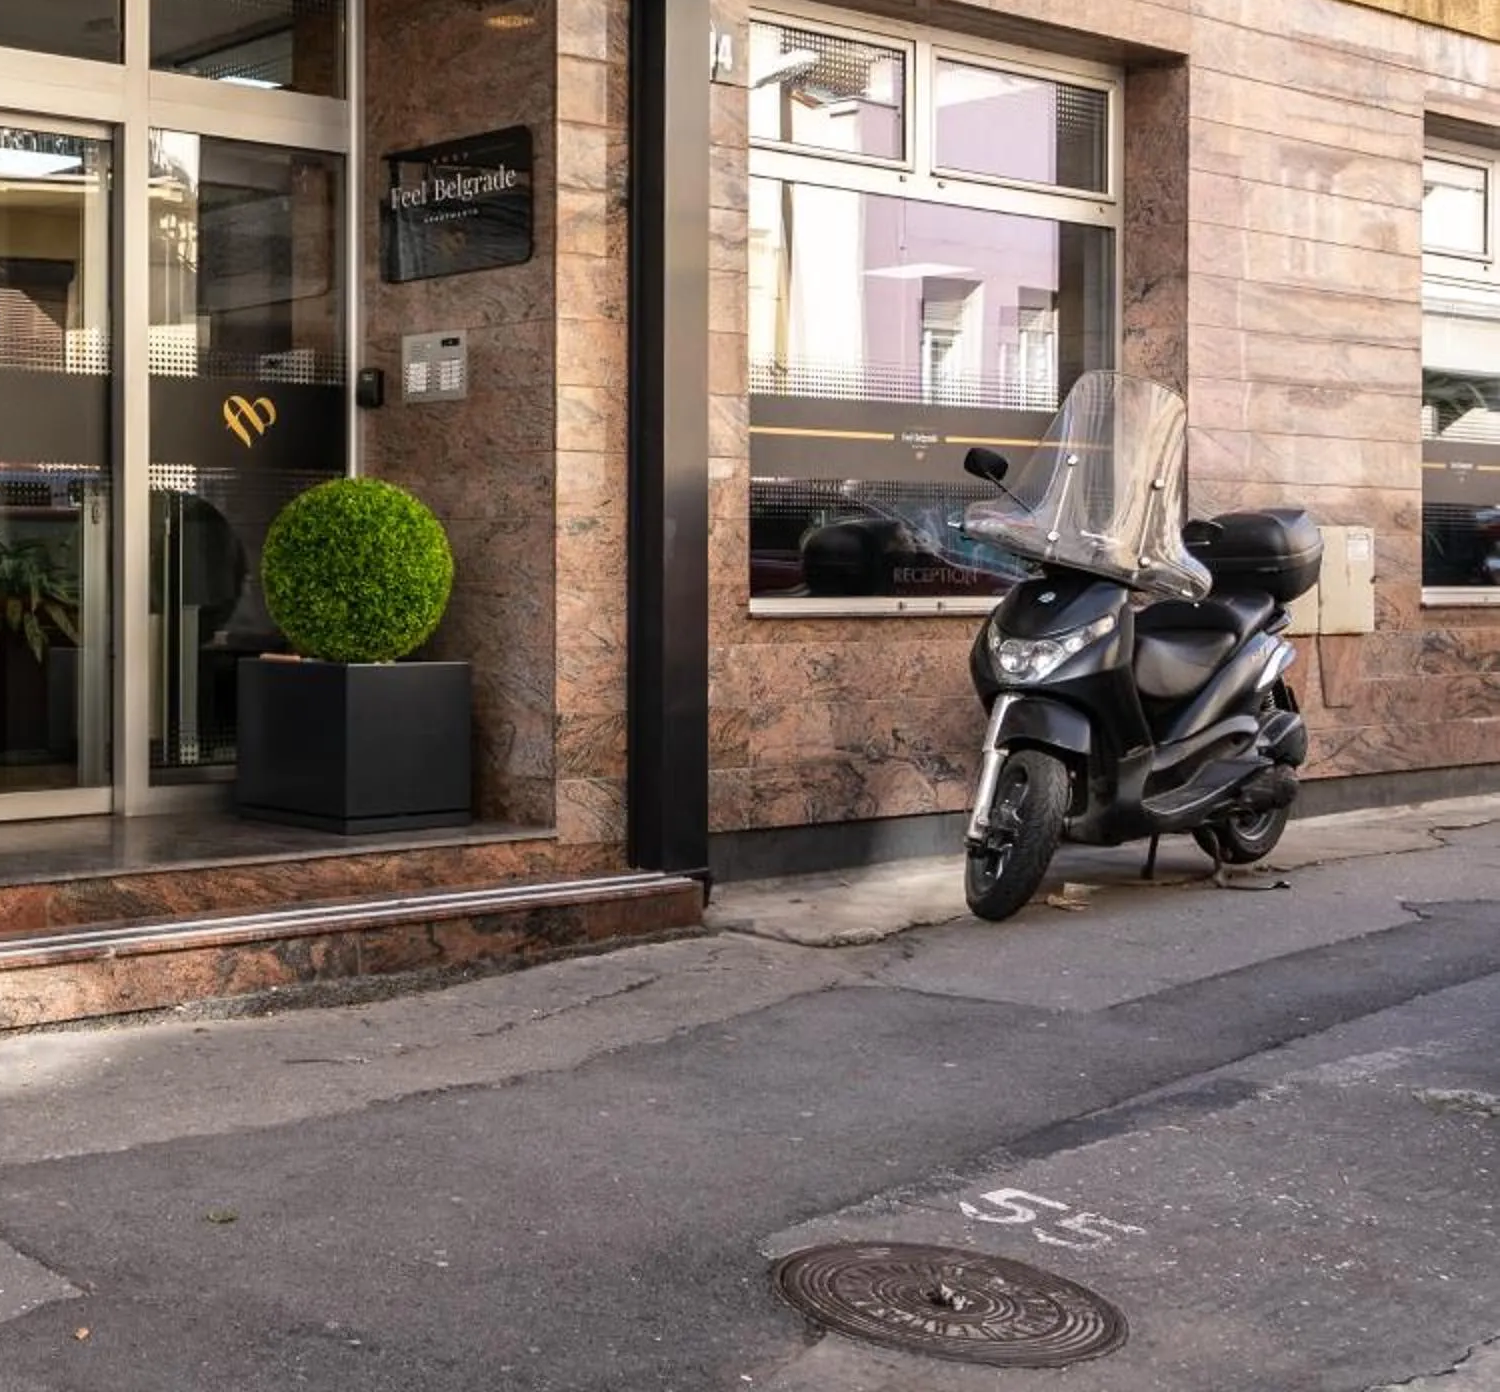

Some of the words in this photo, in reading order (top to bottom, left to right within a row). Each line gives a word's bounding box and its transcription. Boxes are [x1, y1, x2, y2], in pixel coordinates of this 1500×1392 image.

[391, 180, 428, 210] Feel
[435, 163, 517, 202] Belgrade
[893, 566, 978, 584] RECEPTION
